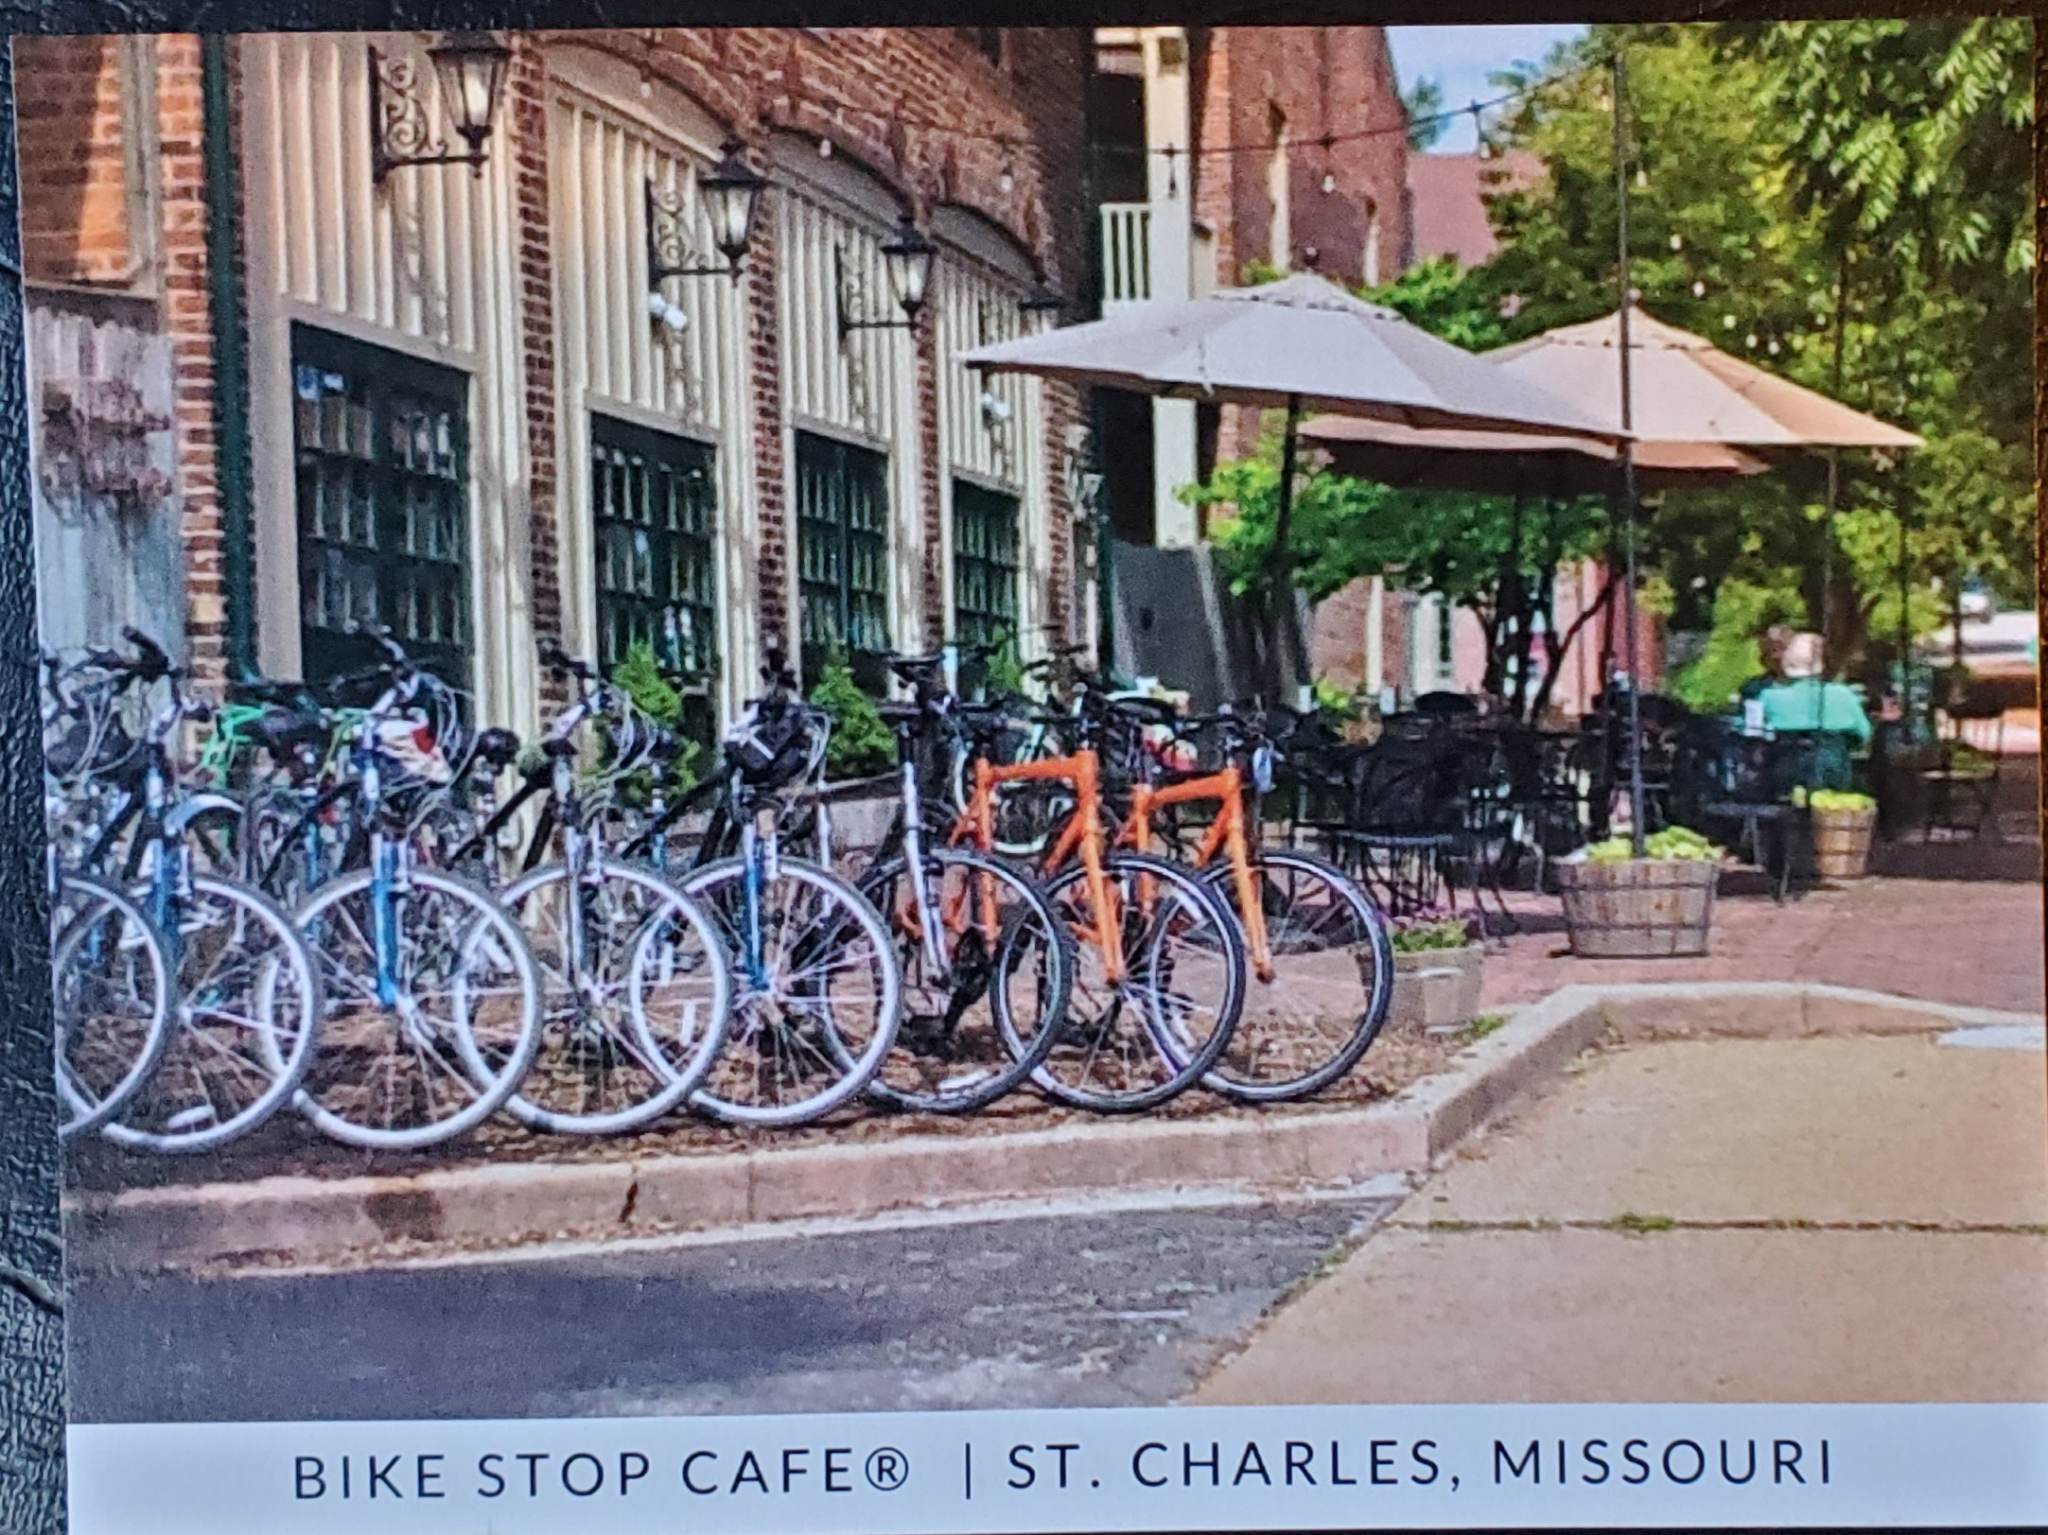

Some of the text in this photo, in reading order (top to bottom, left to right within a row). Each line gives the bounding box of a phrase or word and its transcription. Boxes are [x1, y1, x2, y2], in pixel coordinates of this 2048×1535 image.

[295, 1455, 446, 1500] BIKE
[477, 1452, 651, 1498] STOP
[1007, 1443, 1101, 1491] ST.
[1132, 1440, 1461, 1493] CHARLES,
[1493, 1438, 1831, 1486] MISSOURI
